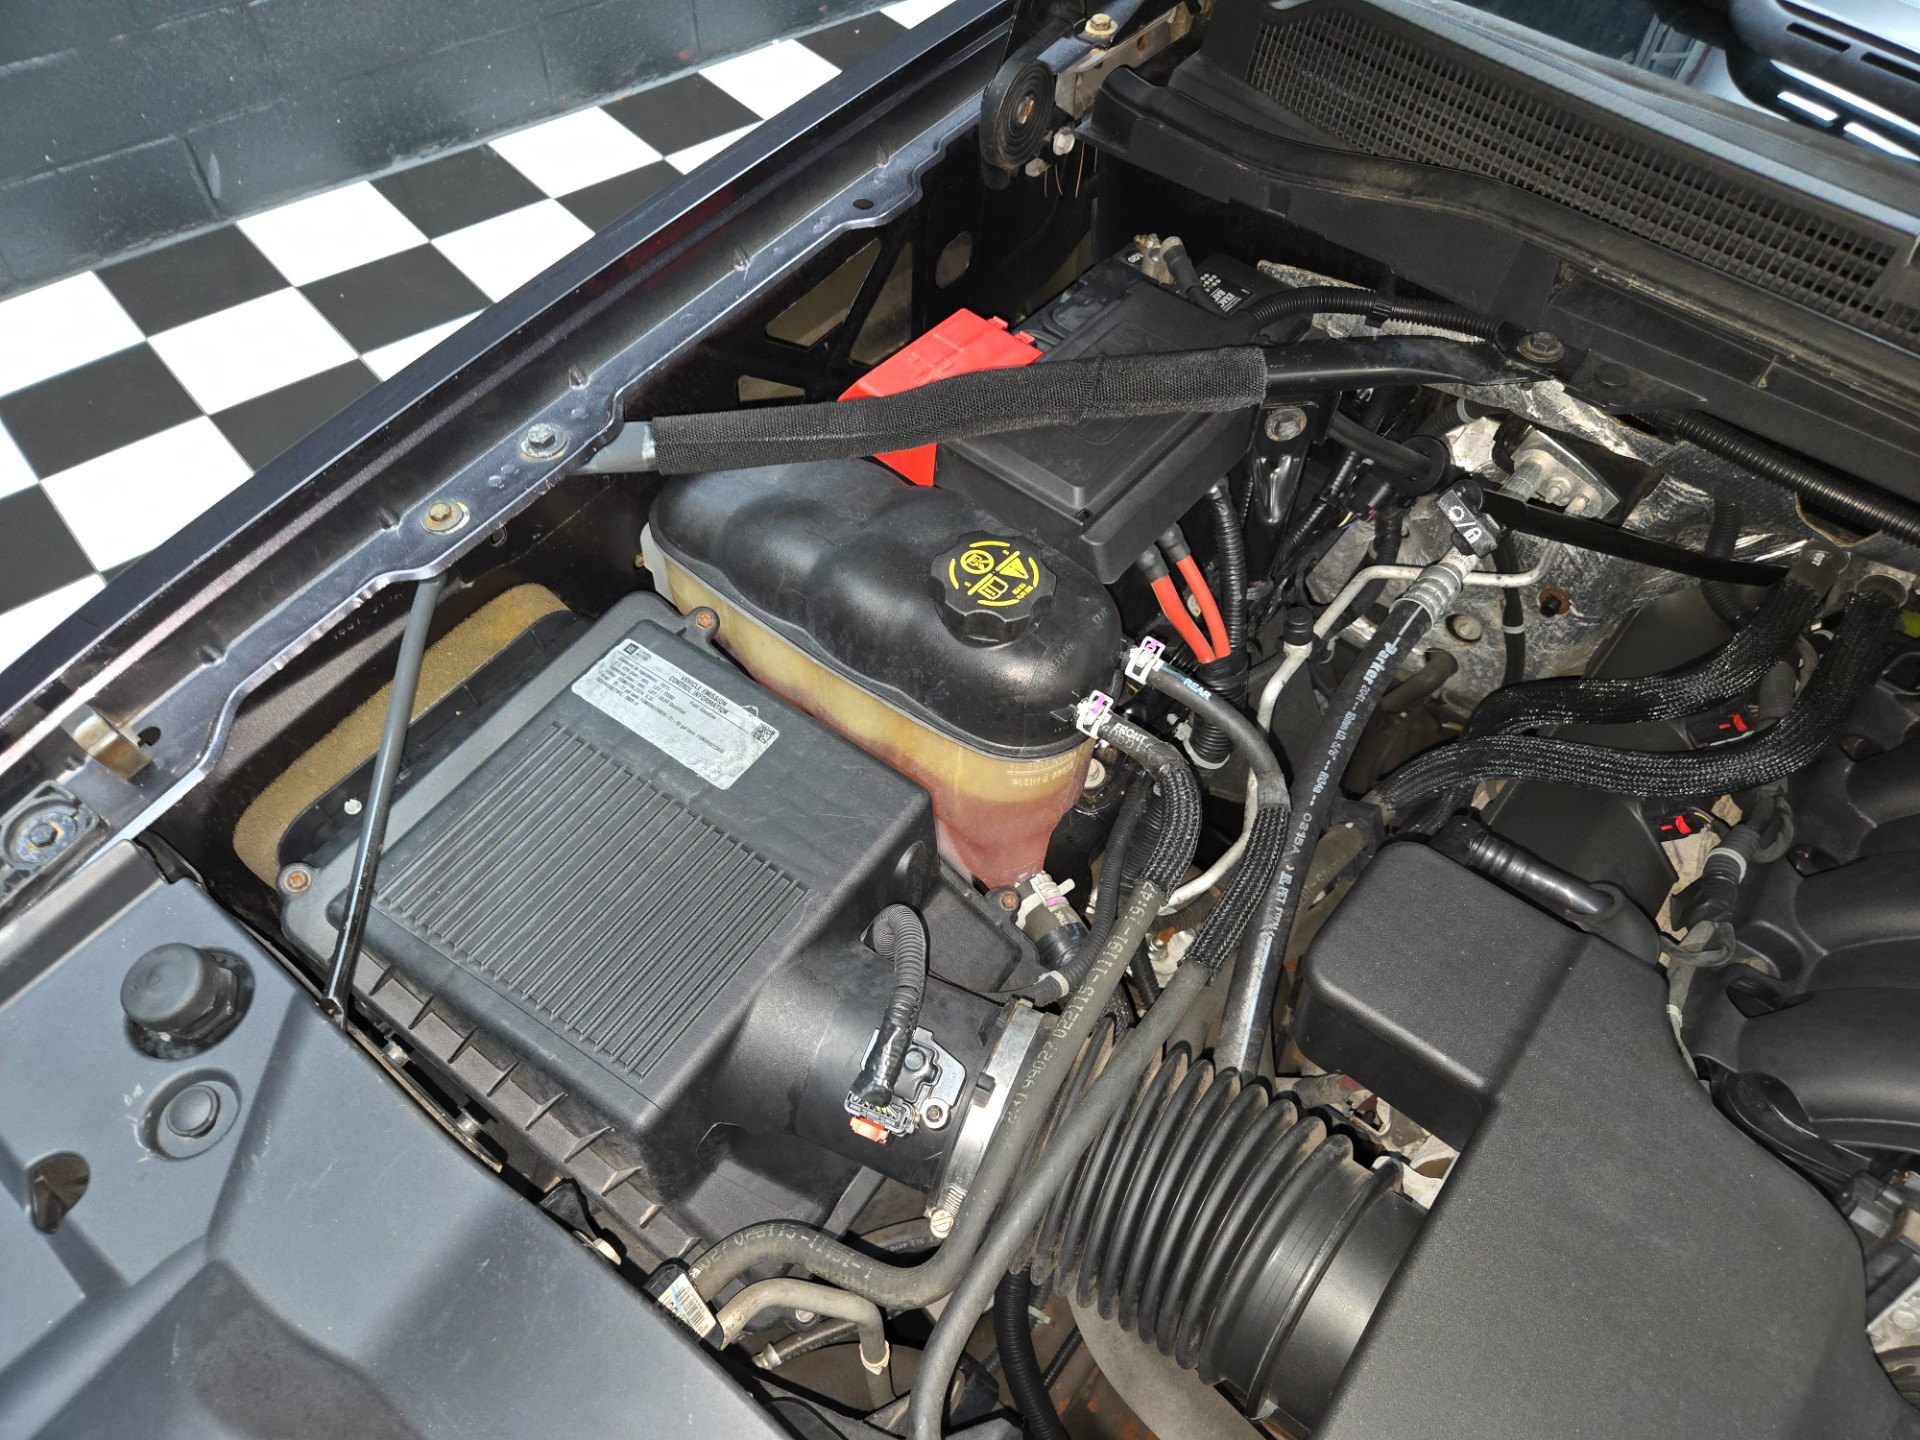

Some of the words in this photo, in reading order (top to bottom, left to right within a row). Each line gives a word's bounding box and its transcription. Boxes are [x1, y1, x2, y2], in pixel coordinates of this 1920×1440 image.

[1362, 640, 1398, 687] Parker
[667, 675, 694, 693] CONTROL
[690, 690, 729, 715] INFORMATION
[679, 674, 703, 691] VEHICLE
[700, 688, 728, 706] EMISSION
[1182, 677, 1212, 701] REAR
[1357, 683, 1371, 703] 2041
[1112, 720, 1149, 745] FRONT
[1291, 812, 1313, 855] 0315A
